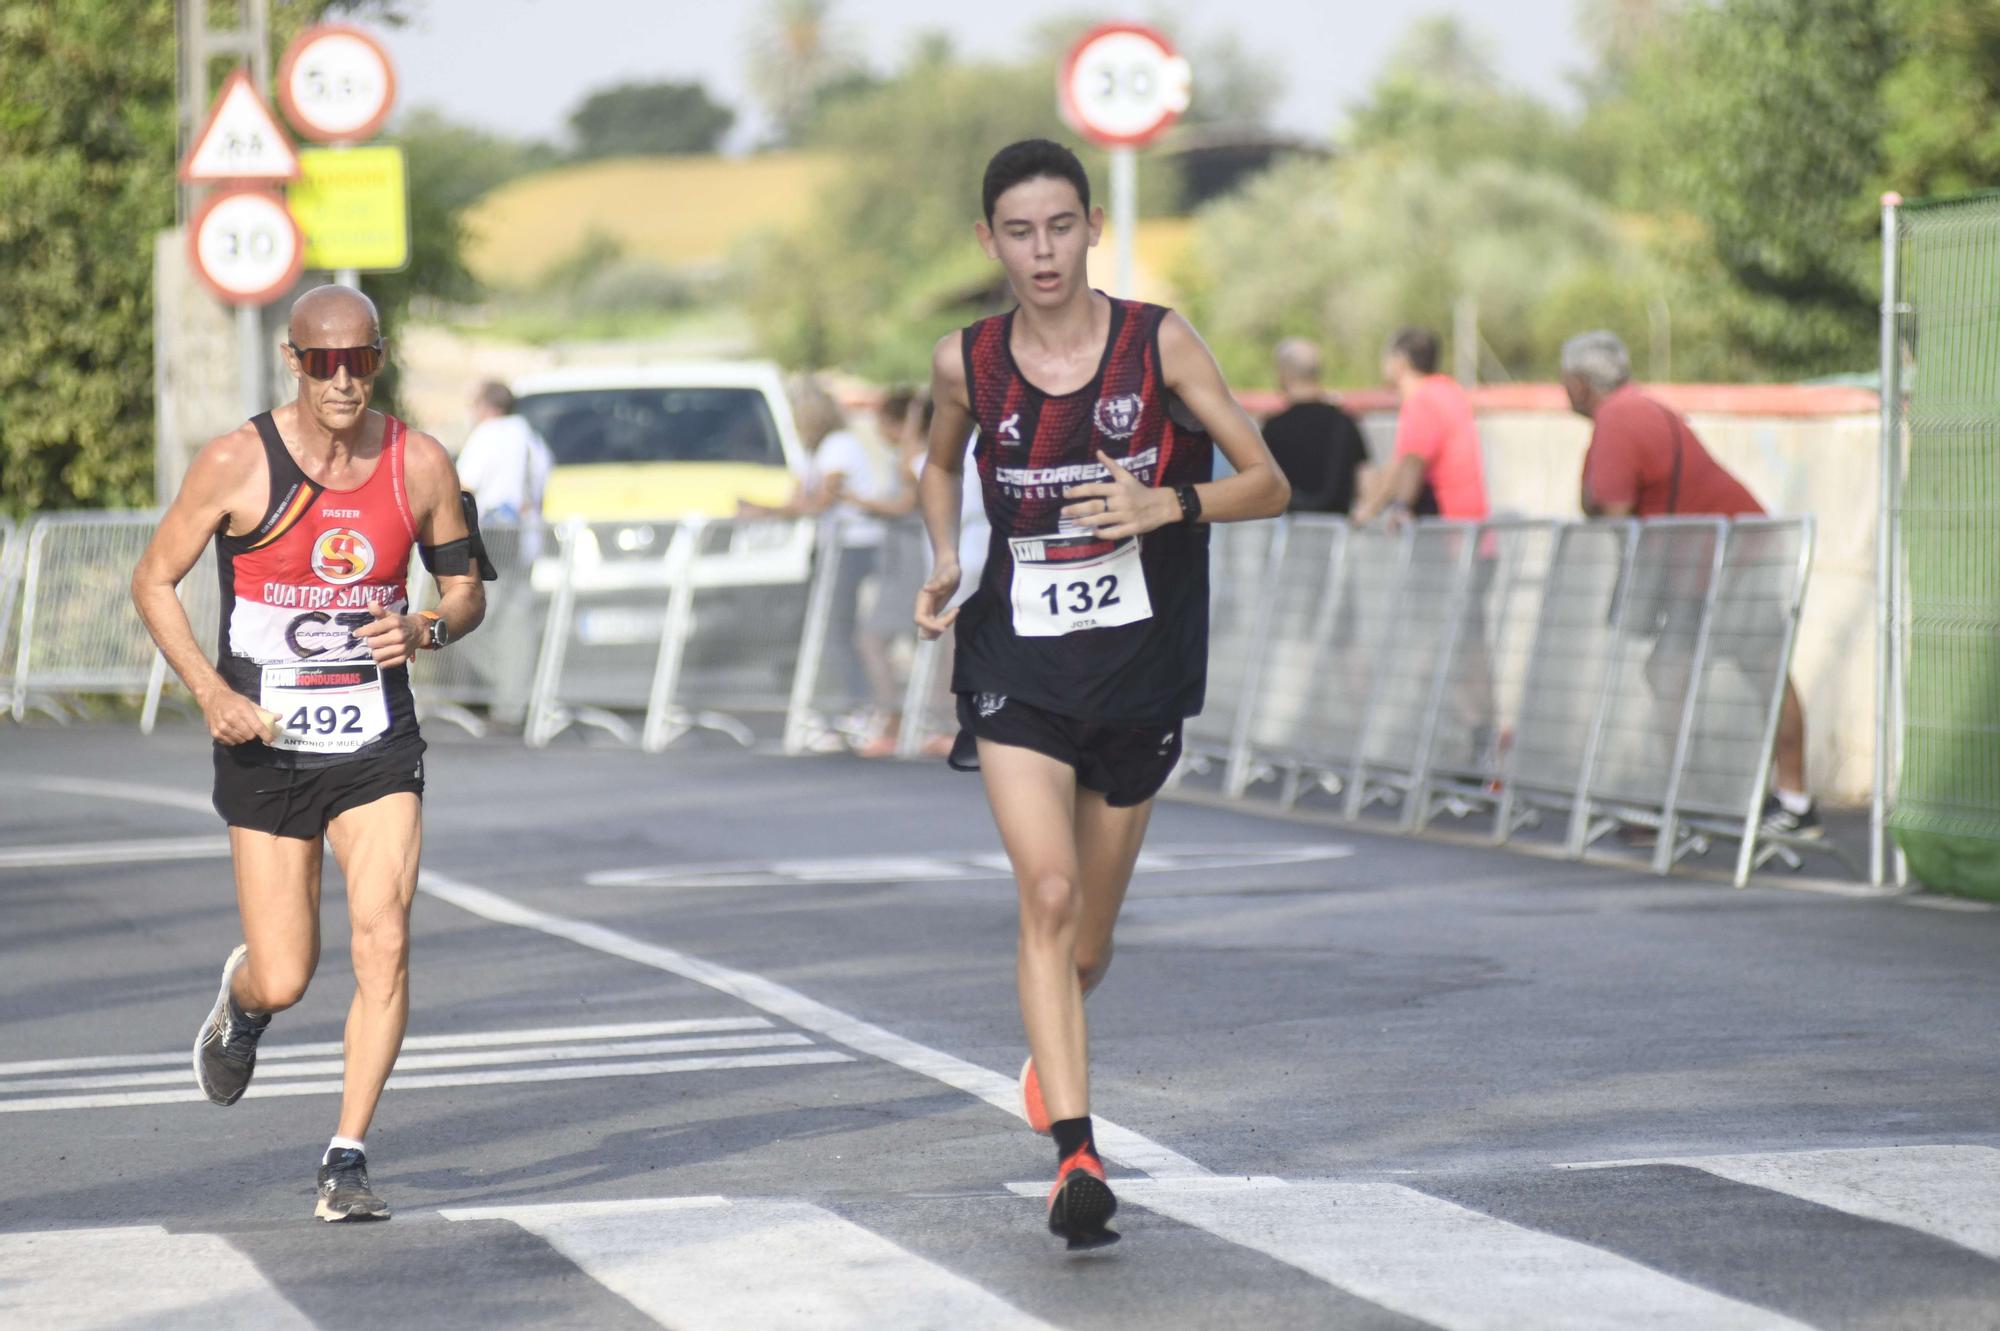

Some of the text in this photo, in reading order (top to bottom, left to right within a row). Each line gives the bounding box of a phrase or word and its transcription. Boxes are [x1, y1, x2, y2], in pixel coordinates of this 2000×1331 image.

[1089, 61, 1159, 104] 30
[216, 221, 278, 264] 30
[322, 509, 361, 519] FASTER
[263, 582, 334, 609] CUATRO
[1041, 574, 1120, 615] 132
[1071, 618, 1098, 630] JOTA
[286, 705, 363, 735] 492
[284, 738, 325, 748] ANTONIO
